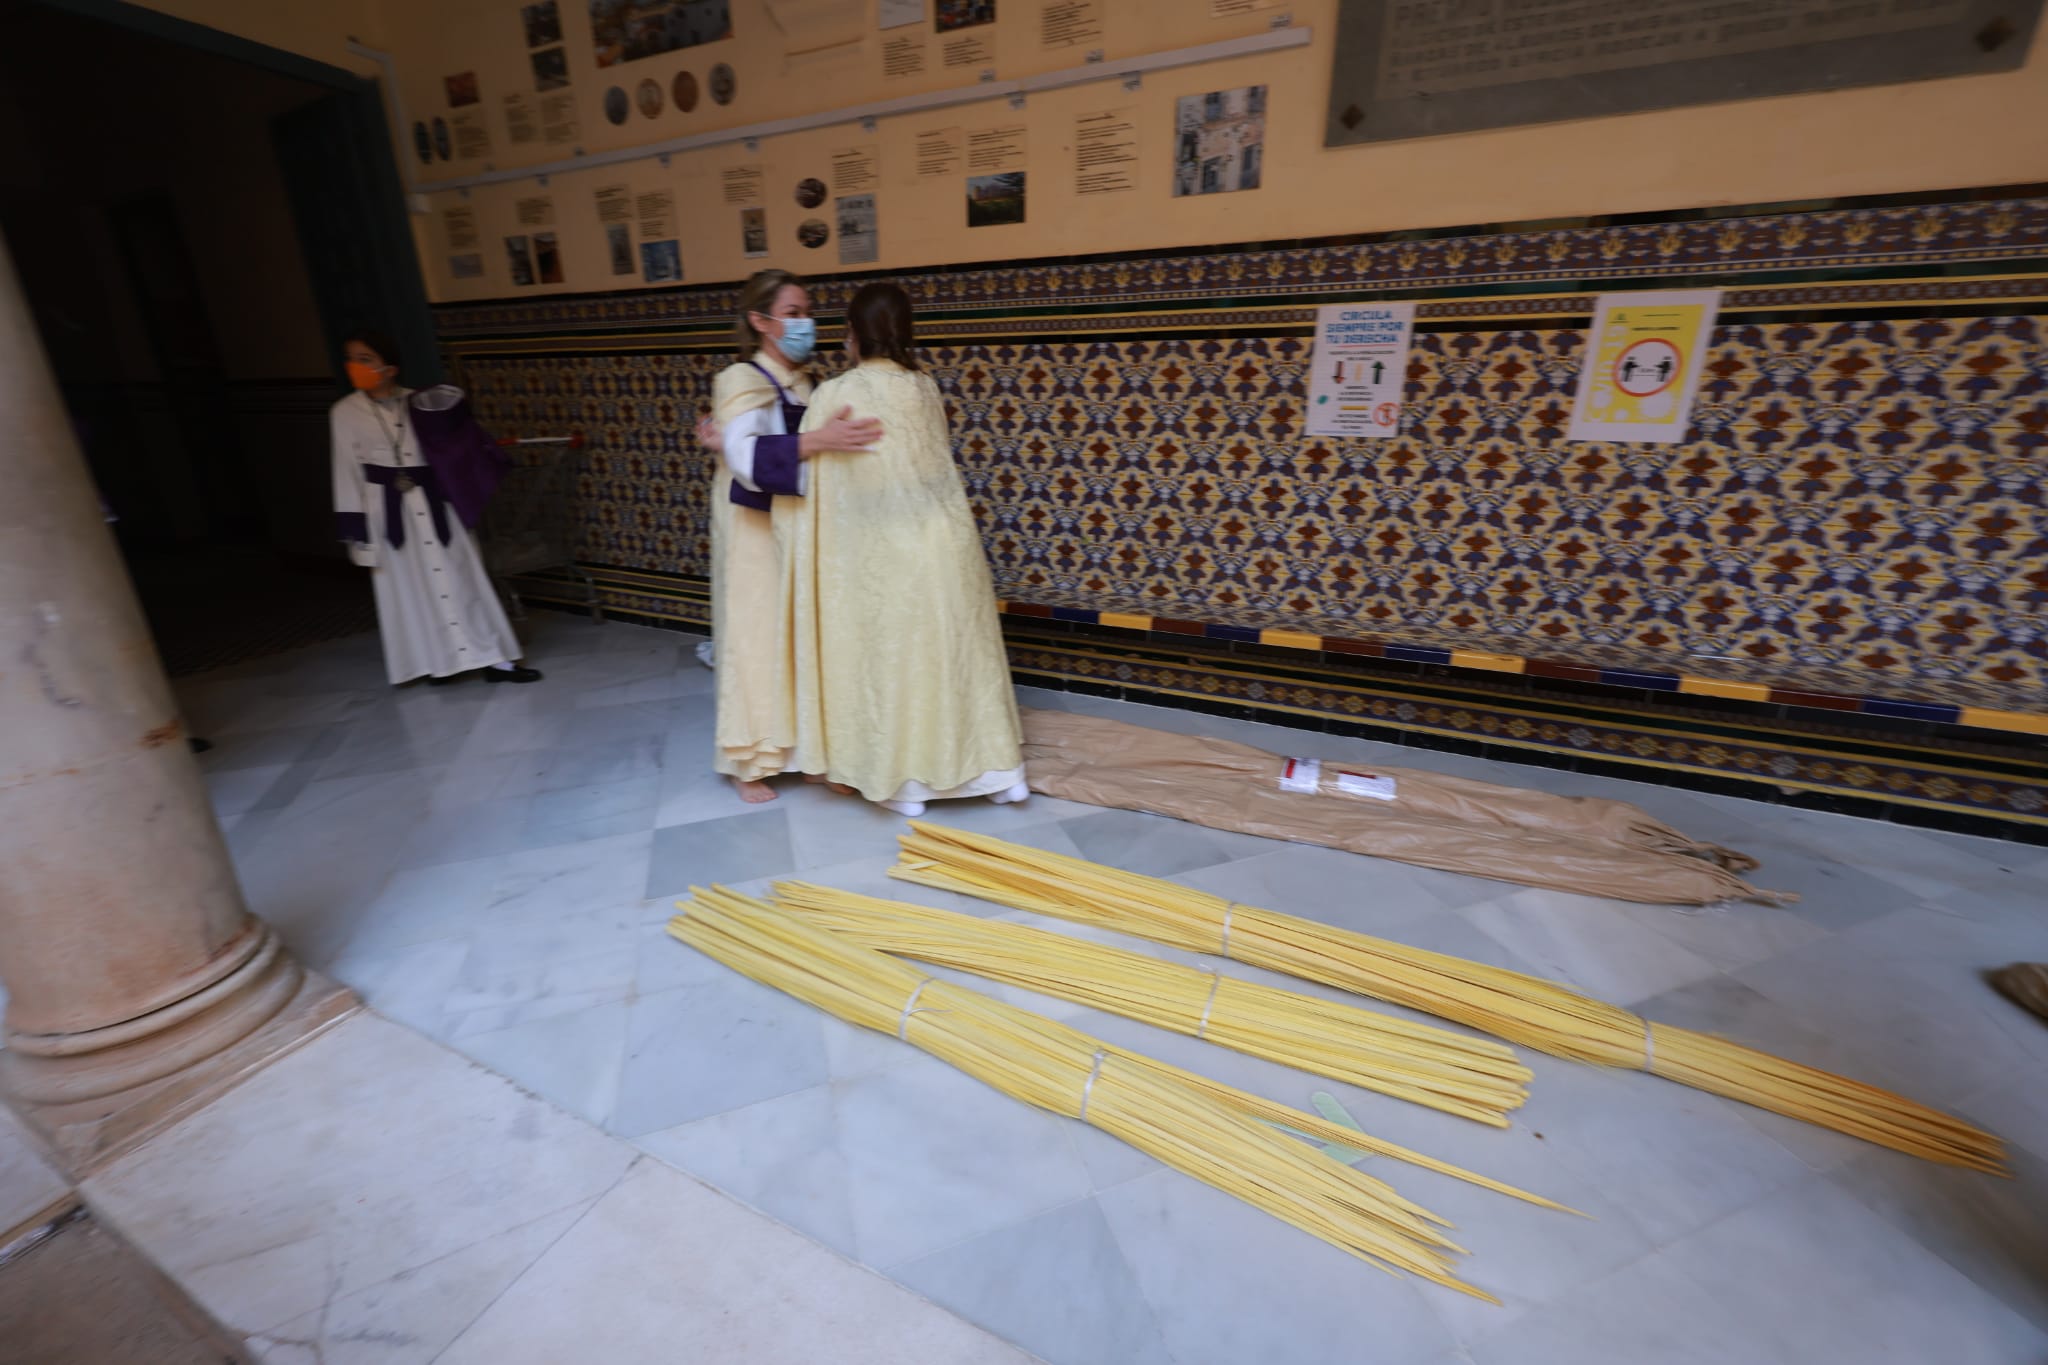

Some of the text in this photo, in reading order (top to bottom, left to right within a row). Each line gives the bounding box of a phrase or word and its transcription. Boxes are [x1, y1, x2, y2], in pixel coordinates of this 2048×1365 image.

[1341, 311, 1392, 321] CIRCULA
[1327, 321, 1404, 333] SIEMPRE POR
[1326, 334, 1398, 344] TU DERECHA
